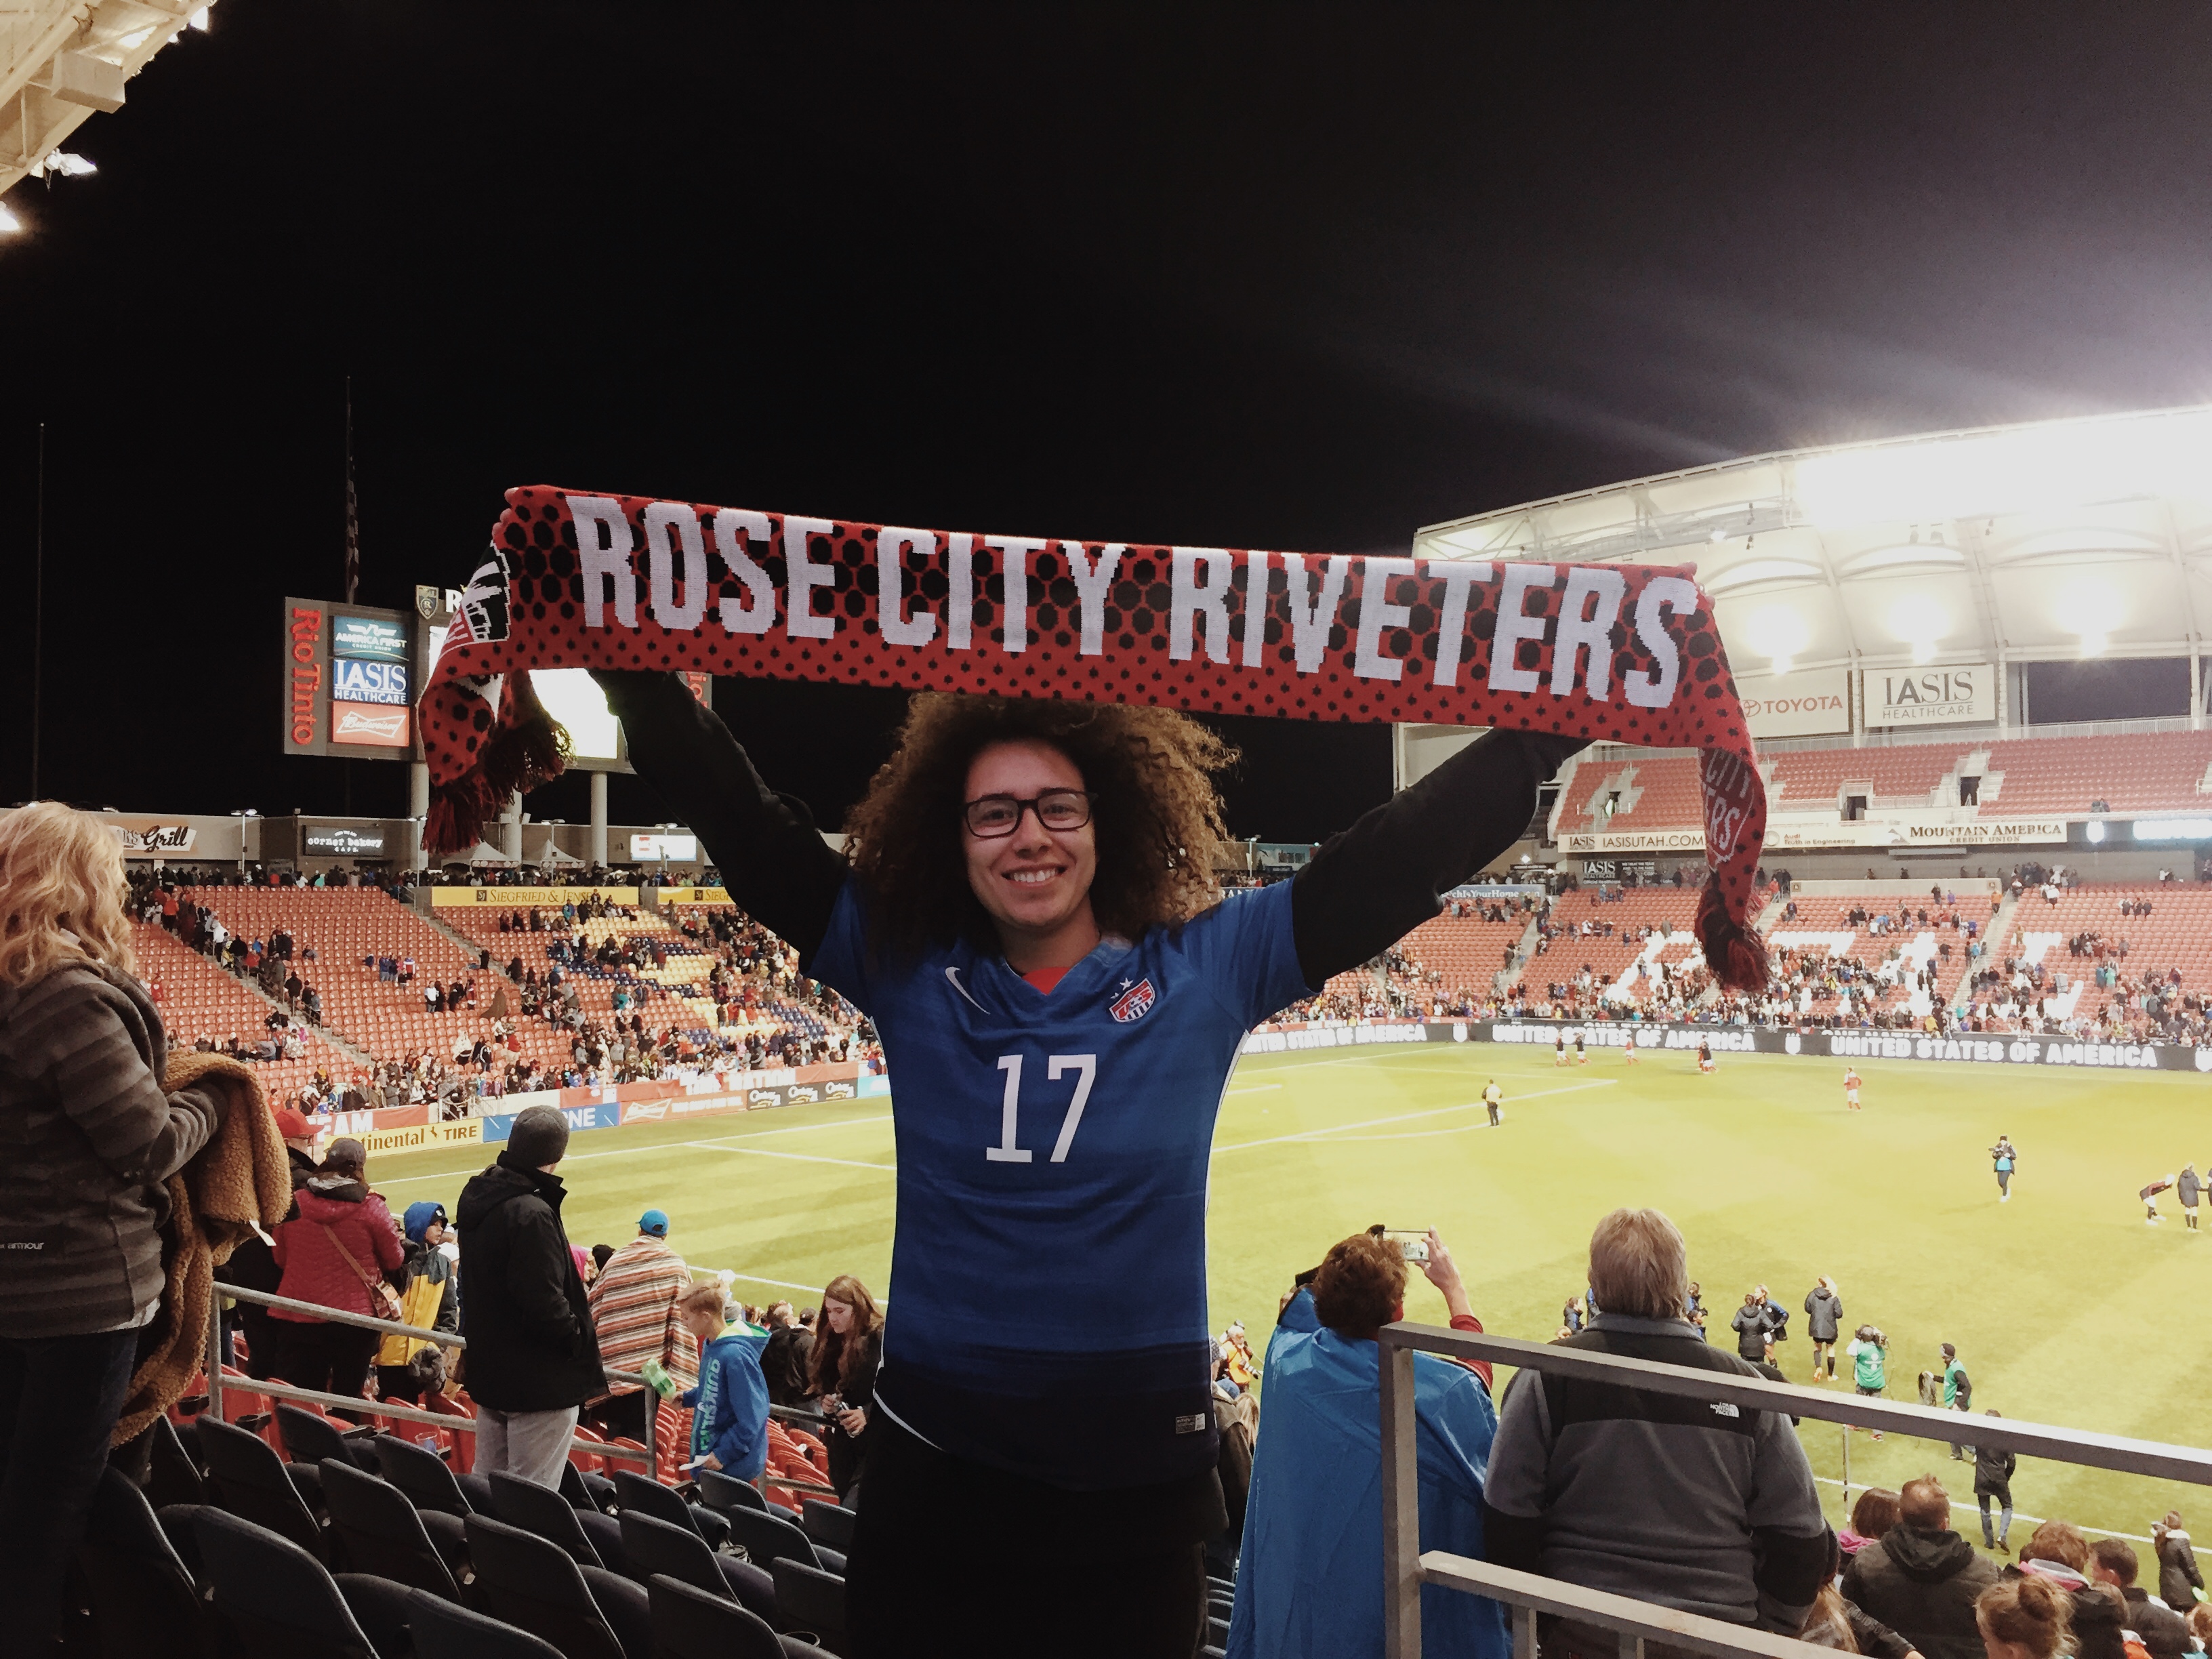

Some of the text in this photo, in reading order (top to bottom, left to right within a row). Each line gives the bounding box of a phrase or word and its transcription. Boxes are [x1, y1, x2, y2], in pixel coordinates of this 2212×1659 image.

[565, 495, 1698, 708] ROSE CITY RIVETERS
[335, 632, 407, 648] AMERICA FIRST
[291, 607, 321, 745] Rio Tinto
[335, 660, 406, 692] IASIS
[1883, 671, 1973, 705] IASIS
[335, 690, 407, 704] HEALTHCARE
[1764, 695, 1843, 714] TOYOTA
[1883, 704, 1973, 719] HEALTHCARE
[140, 825, 188, 853] Grill
[1910, 825, 2062, 838] MOUNTAIN AMERICA
[1570, 836, 1595, 846] IASIS
[1603, 835, 1704, 848] IASISUTAH.COM
[1584, 861, 1616, 874] IASIS
[490, 889, 546, 902] SIEGFRIED
[548, 890, 559, 902] &
[562, 890, 594, 903] JENSE
[1492, 1024, 1559, 1043] UNITED
[1636, 1029, 1661, 1048] OF
[1665, 1030, 1755, 1051] AMERICA
[1831, 1036, 2158, 1067] UNITED STATES OF AMERICA
[986, 1054, 1097, 1163] 17
[444, 1126, 477, 1141] TIRE
